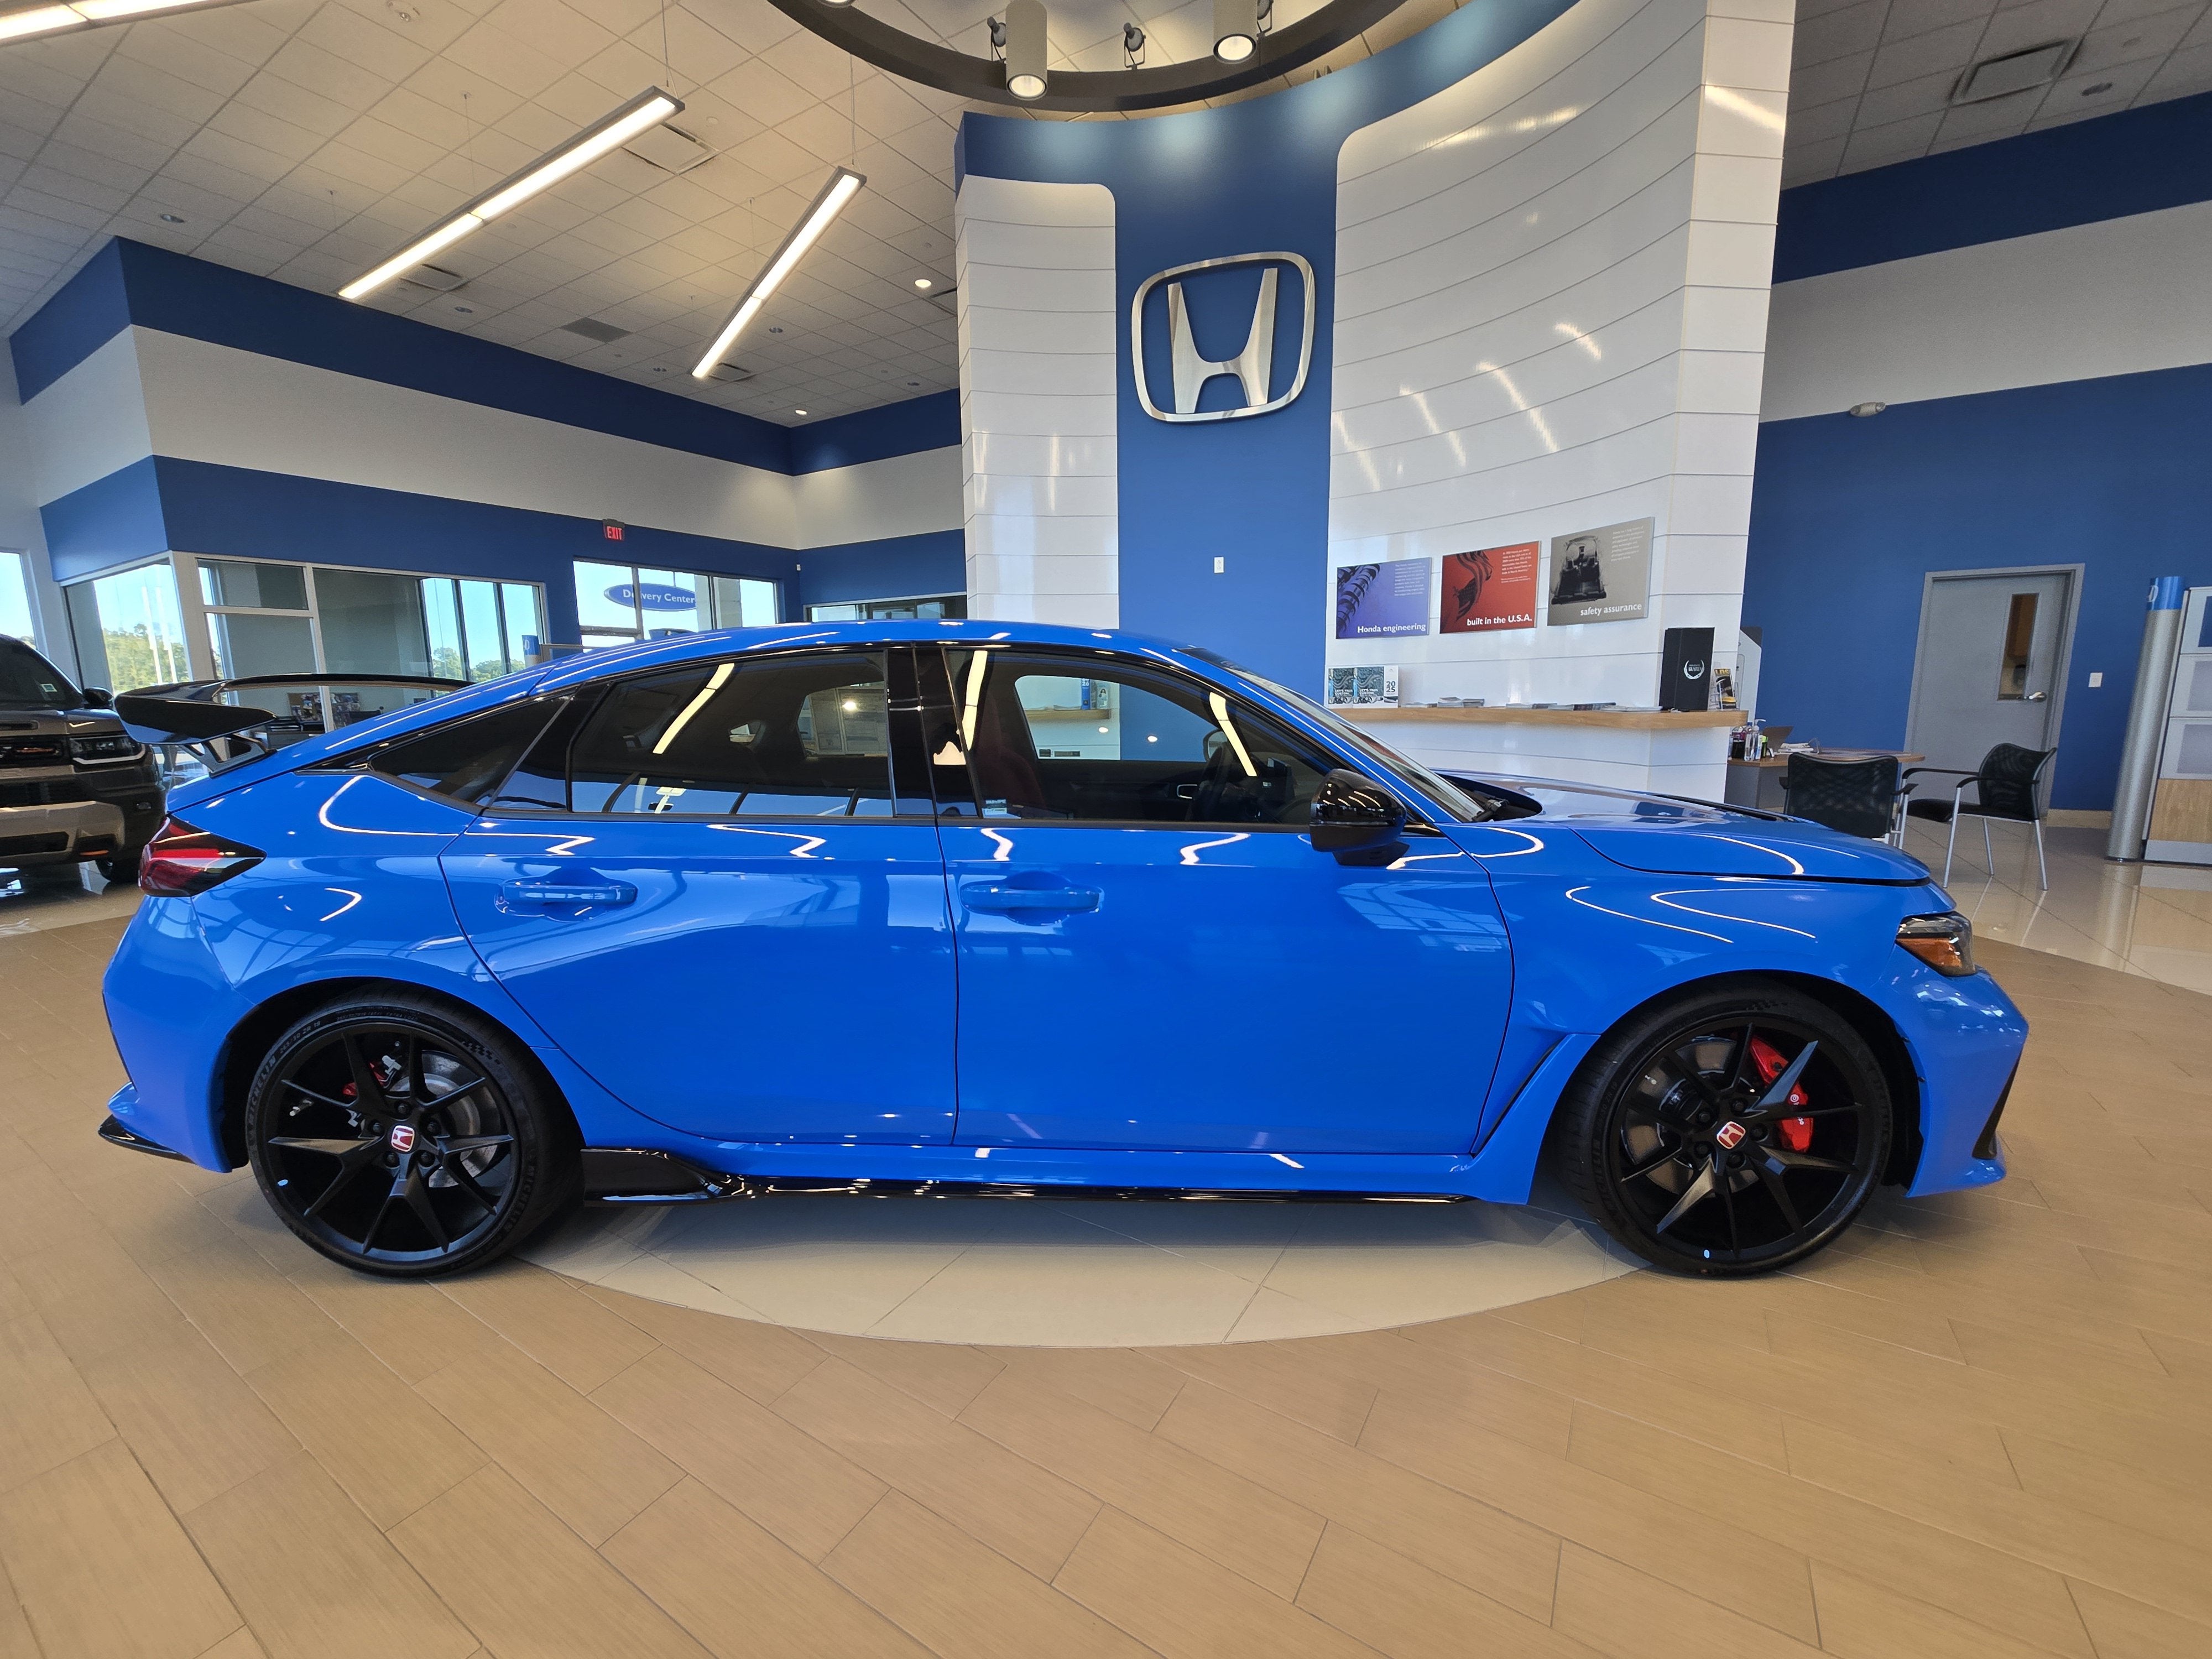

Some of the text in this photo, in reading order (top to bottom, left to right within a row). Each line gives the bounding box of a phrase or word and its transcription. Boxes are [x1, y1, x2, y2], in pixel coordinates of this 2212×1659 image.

[607, 526, 622, 540] EXIT
[623, 588, 695, 603] Dvery Center
[1580, 603, 1642, 616] safety assurance
[1467, 617, 1484, 626] built
[1493, 616, 1506, 624] the
[1507, 613, 1532, 623] U.S.A.
[1357, 623, 1426, 633] Honda engineering
[302, 1025, 311, 1035] ZR
[248, 1055, 276, 1126] MICHELIN
